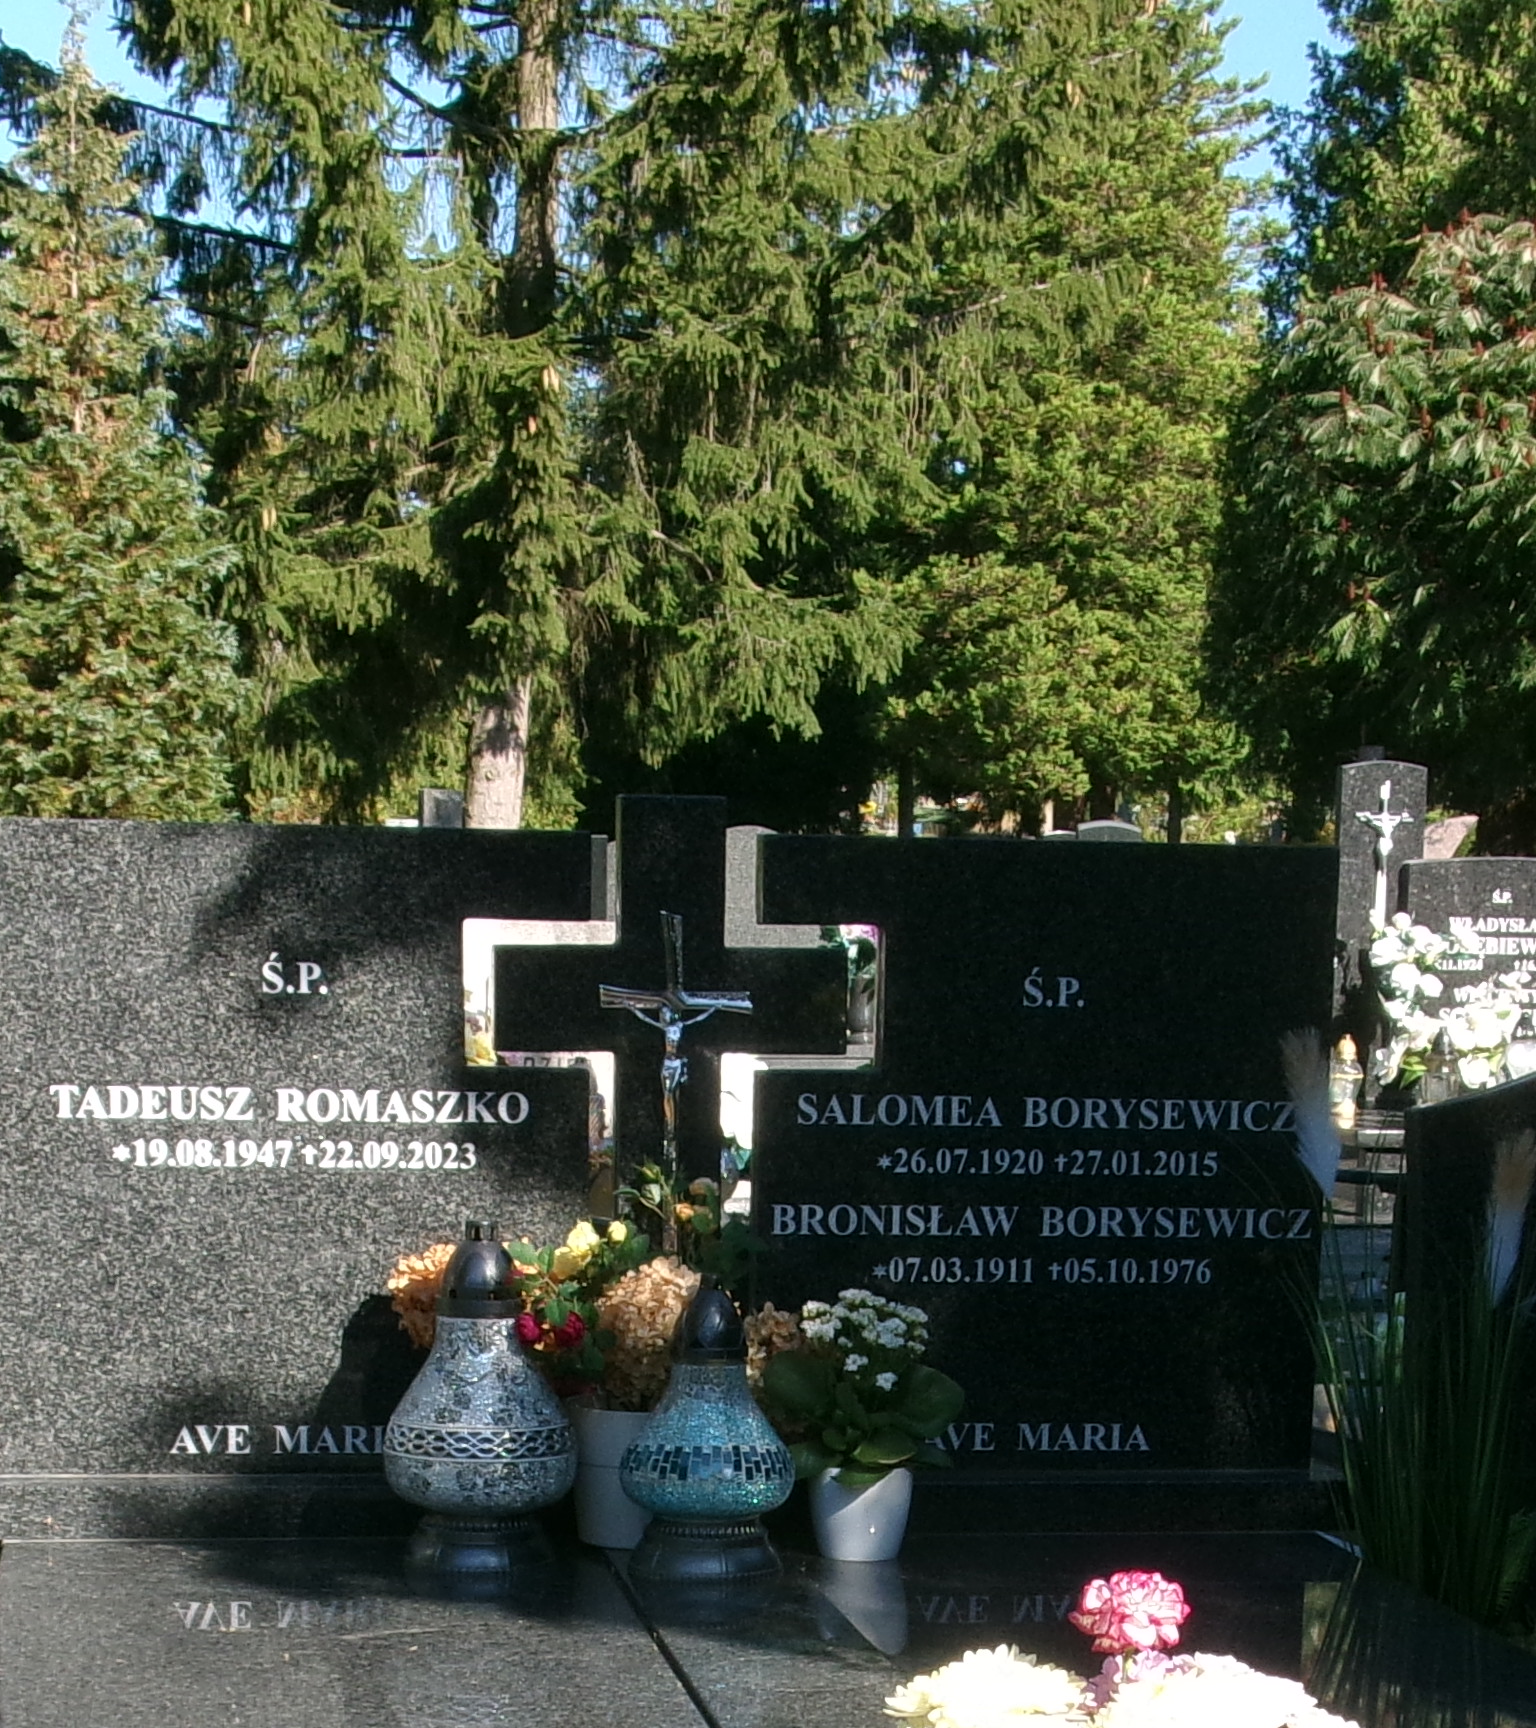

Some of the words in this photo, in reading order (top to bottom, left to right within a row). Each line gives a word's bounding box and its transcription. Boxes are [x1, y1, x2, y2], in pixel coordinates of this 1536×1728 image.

[261, 952, 328, 996] Ś.P.
[1022, 967, 1085, 1009] Ś.P.
[50, 1085, 254, 1121] TADEUSZ
[276, 1088, 530, 1125] ROMASZKO
[797, 1093, 1002, 1128] SALOMEA
[1024, 1097, 1300, 1133] BORYSEWICZ
[772, 1204, 1019, 1237] BRONISŁAW
[1040, 1206, 1312, 1240] BORYSEWICZ
[169, 1424, 253, 1456] AVE
[273, 1425, 384, 1456] MARI
[1017, 1422, 1151, 1452] MARIA
